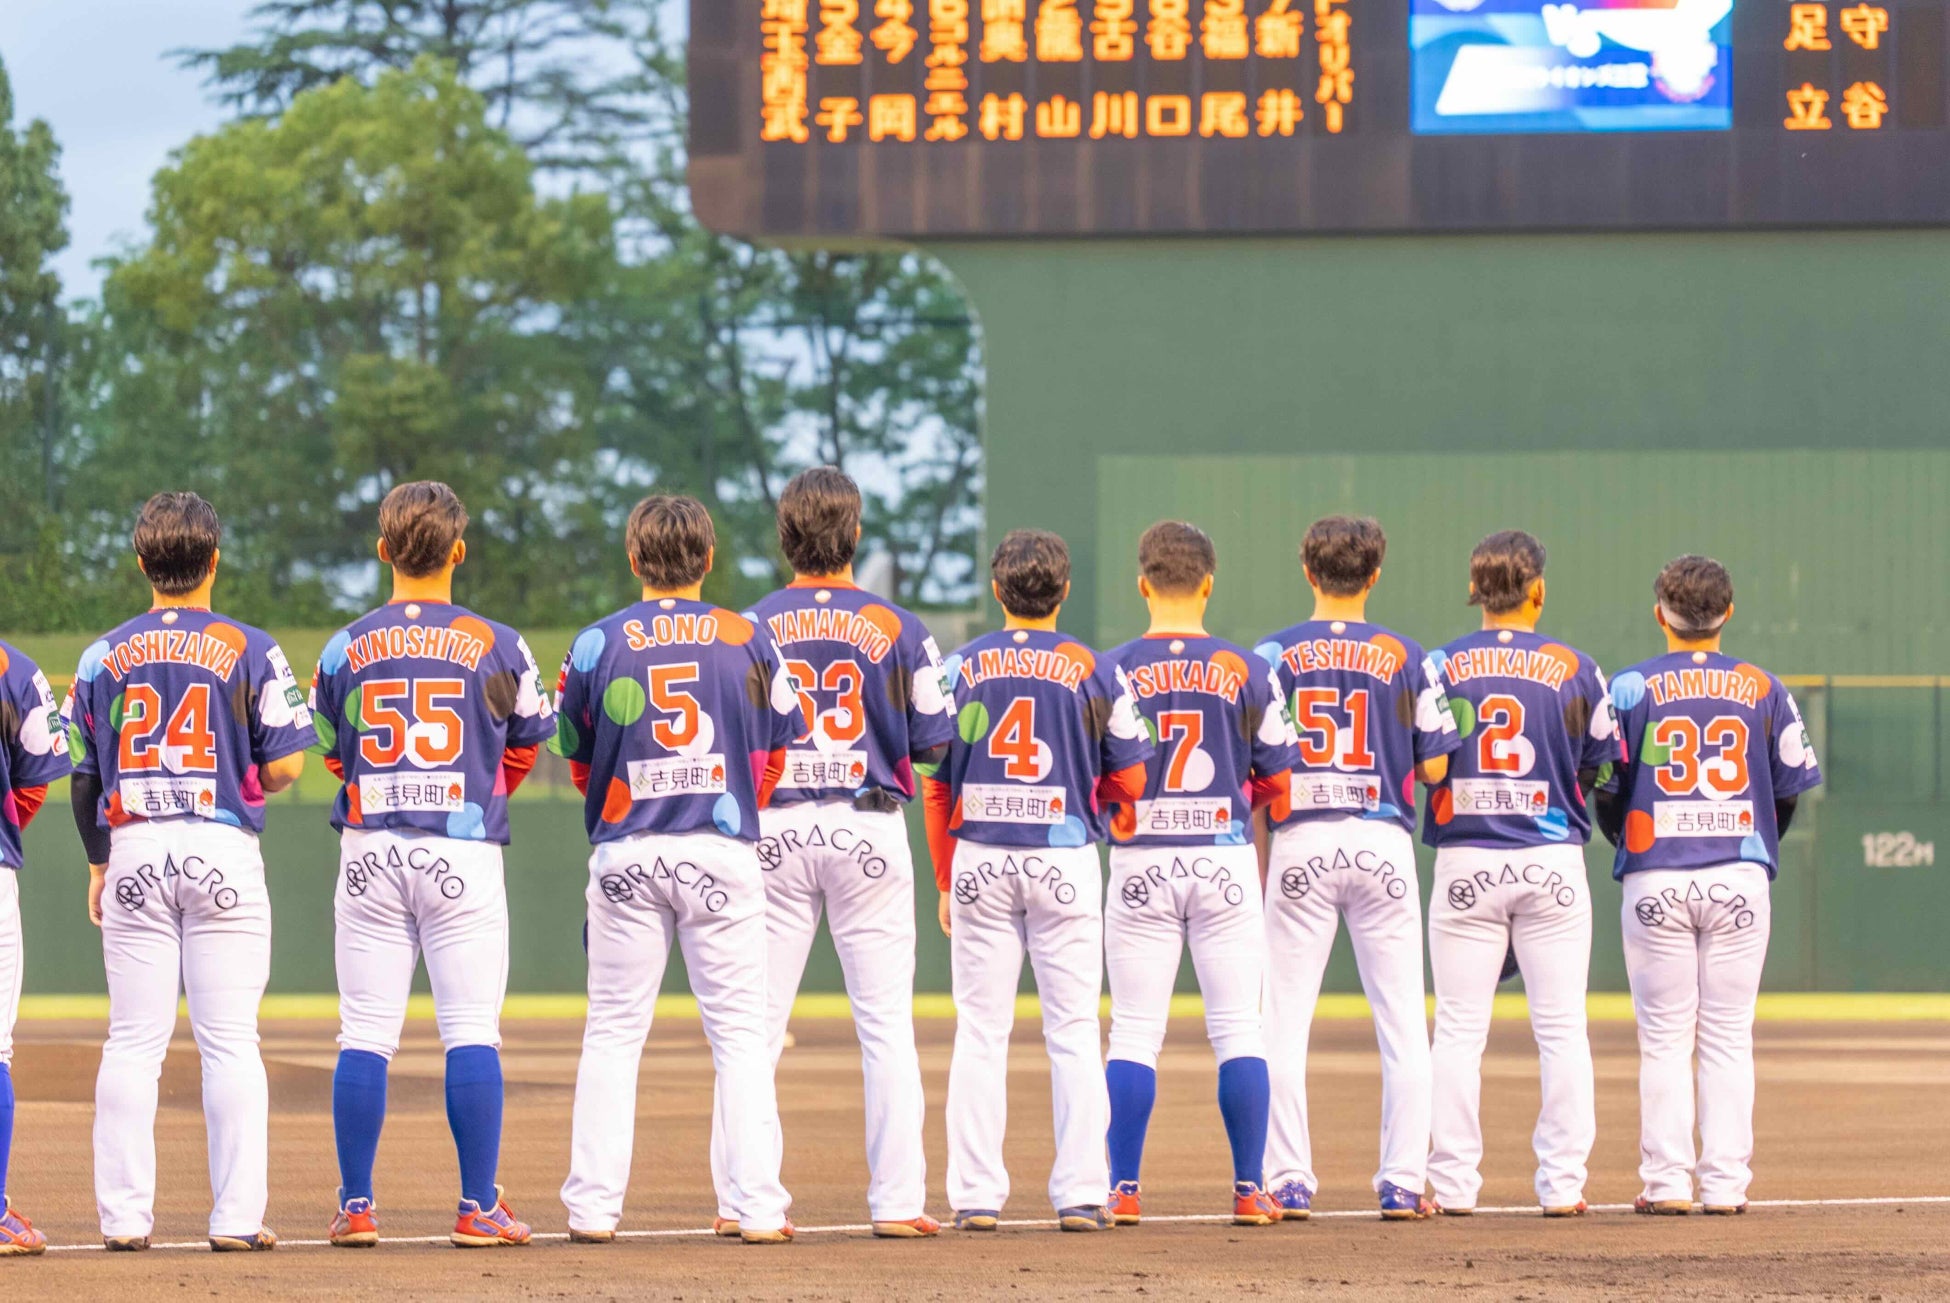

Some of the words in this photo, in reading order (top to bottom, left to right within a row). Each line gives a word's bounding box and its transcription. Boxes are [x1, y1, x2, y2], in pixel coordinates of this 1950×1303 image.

[815, 23, 863, 142] 金子
[1089, 18, 1138, 139] 古川
[344, 625, 484, 674] KINOSHITA
[623, 613, 718, 651] S.ONO
[767, 608, 892, 664] YAMAMOTO
[100, 630, 238, 683] YOSHIZAWA
[959, 648, 1085, 694] Y.MASUDA
[1280, 638, 1396, 686] TESHIMA
[1443, 647, 1568, 692] ICHIKAWA
[648, 661, 700, 751] 5
[1646, 668, 1758, 710] TAMURA
[118, 683, 217, 773] 24
[360, 678, 465, 768] 55
[988, 697, 1039, 778] 4
[1296, 687, 1375, 770] 51
[1478, 693, 1525, 773] 2
[792, 761, 848, 783] 吉見町
[1157, 710, 1203, 792] 7
[1654, 715, 1750, 796] 33
[142, 789, 196, 811] 吉見町
[384, 783, 446, 806] 吉見町
[650, 767, 709, 792] 吉見町
[1312, 784, 1364, 804] 吉見町
[1474, 790, 1531, 810] 吉見町
[985, 795, 1048, 819] 吉見町
[1152, 809, 1213, 830] 吉見町
[1676, 811, 1736, 831] 吉見町
